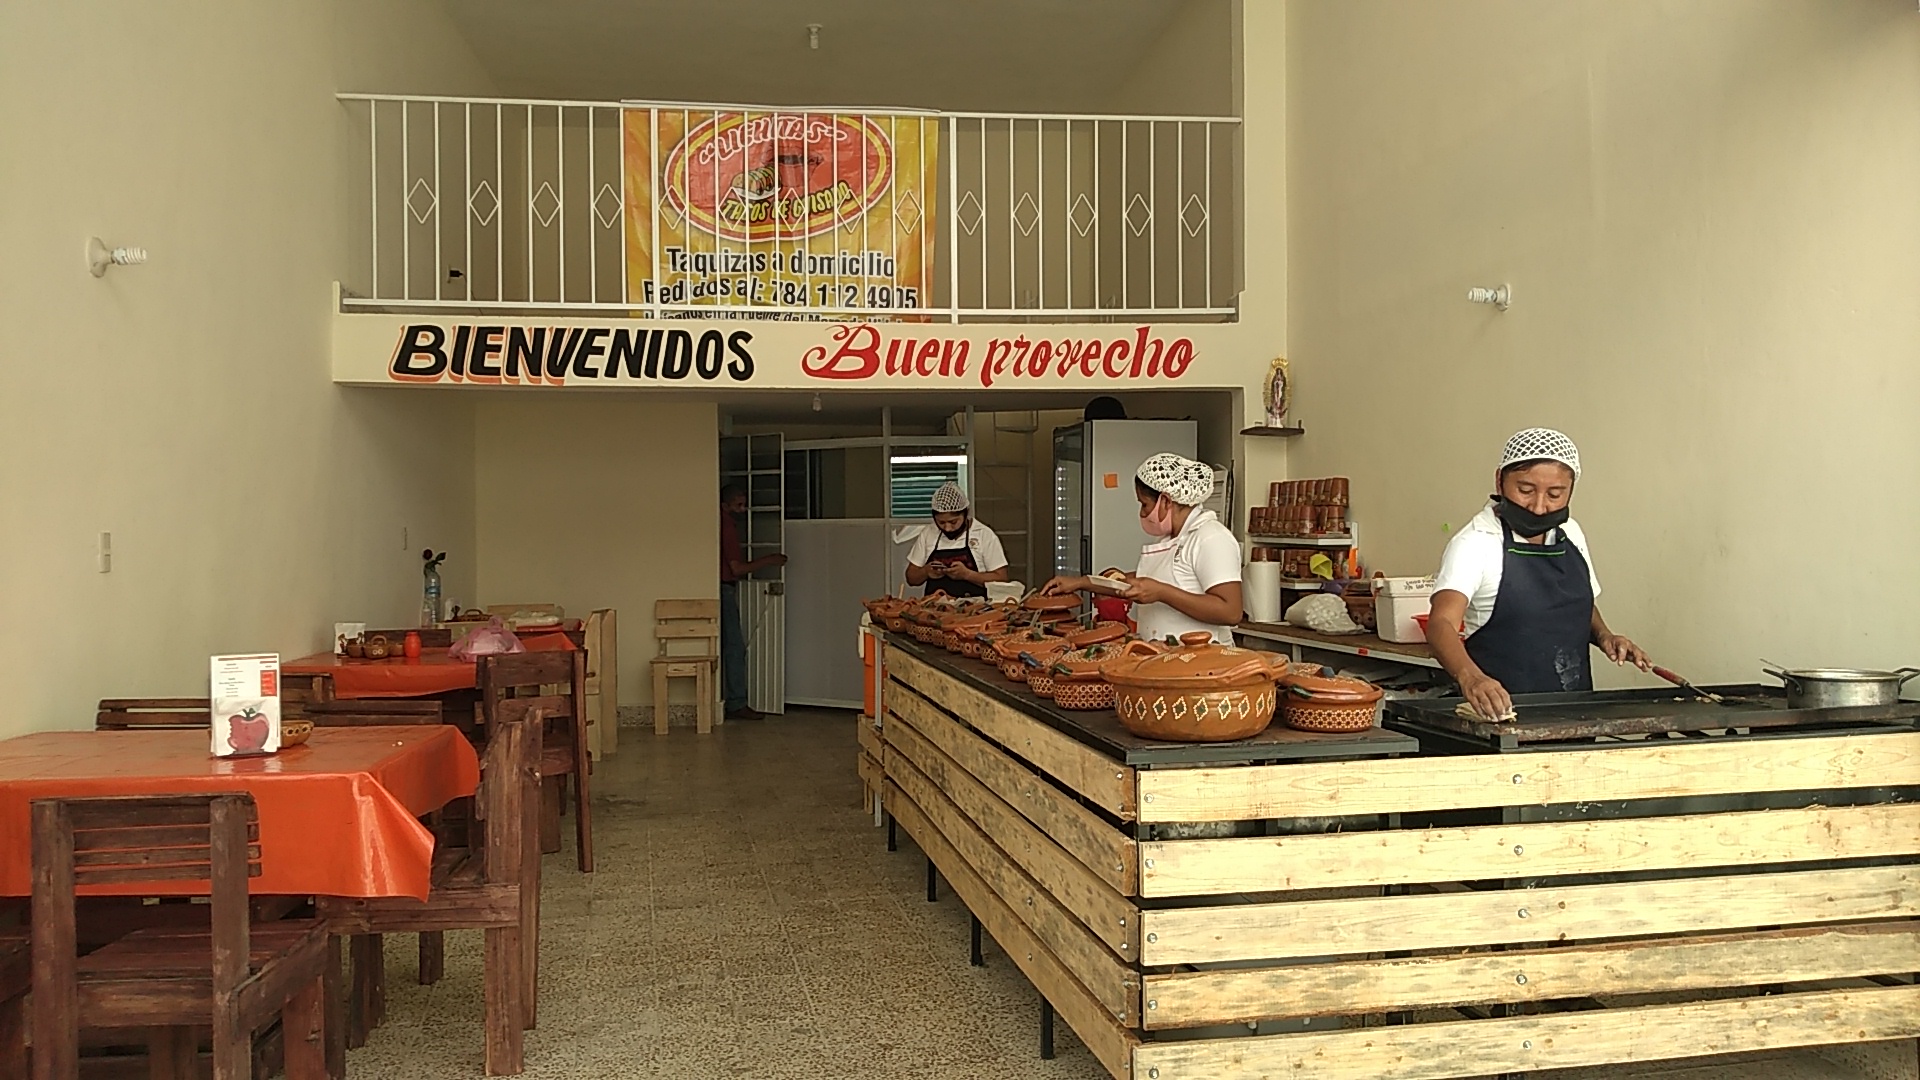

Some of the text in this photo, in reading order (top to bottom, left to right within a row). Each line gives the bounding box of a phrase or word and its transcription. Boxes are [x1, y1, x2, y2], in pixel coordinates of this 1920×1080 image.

[666, 247, 895, 278] Taquizas a domicilio
[643, 278, 731, 305] Peddos
[736, 277, 765, 302] al:
[771, 280, 808, 307] 784
[816, 283, 859, 308] 112
[390, 324, 755, 384] BIENVENIDOS
[801, 324, 1199, 388] Buen provecho
